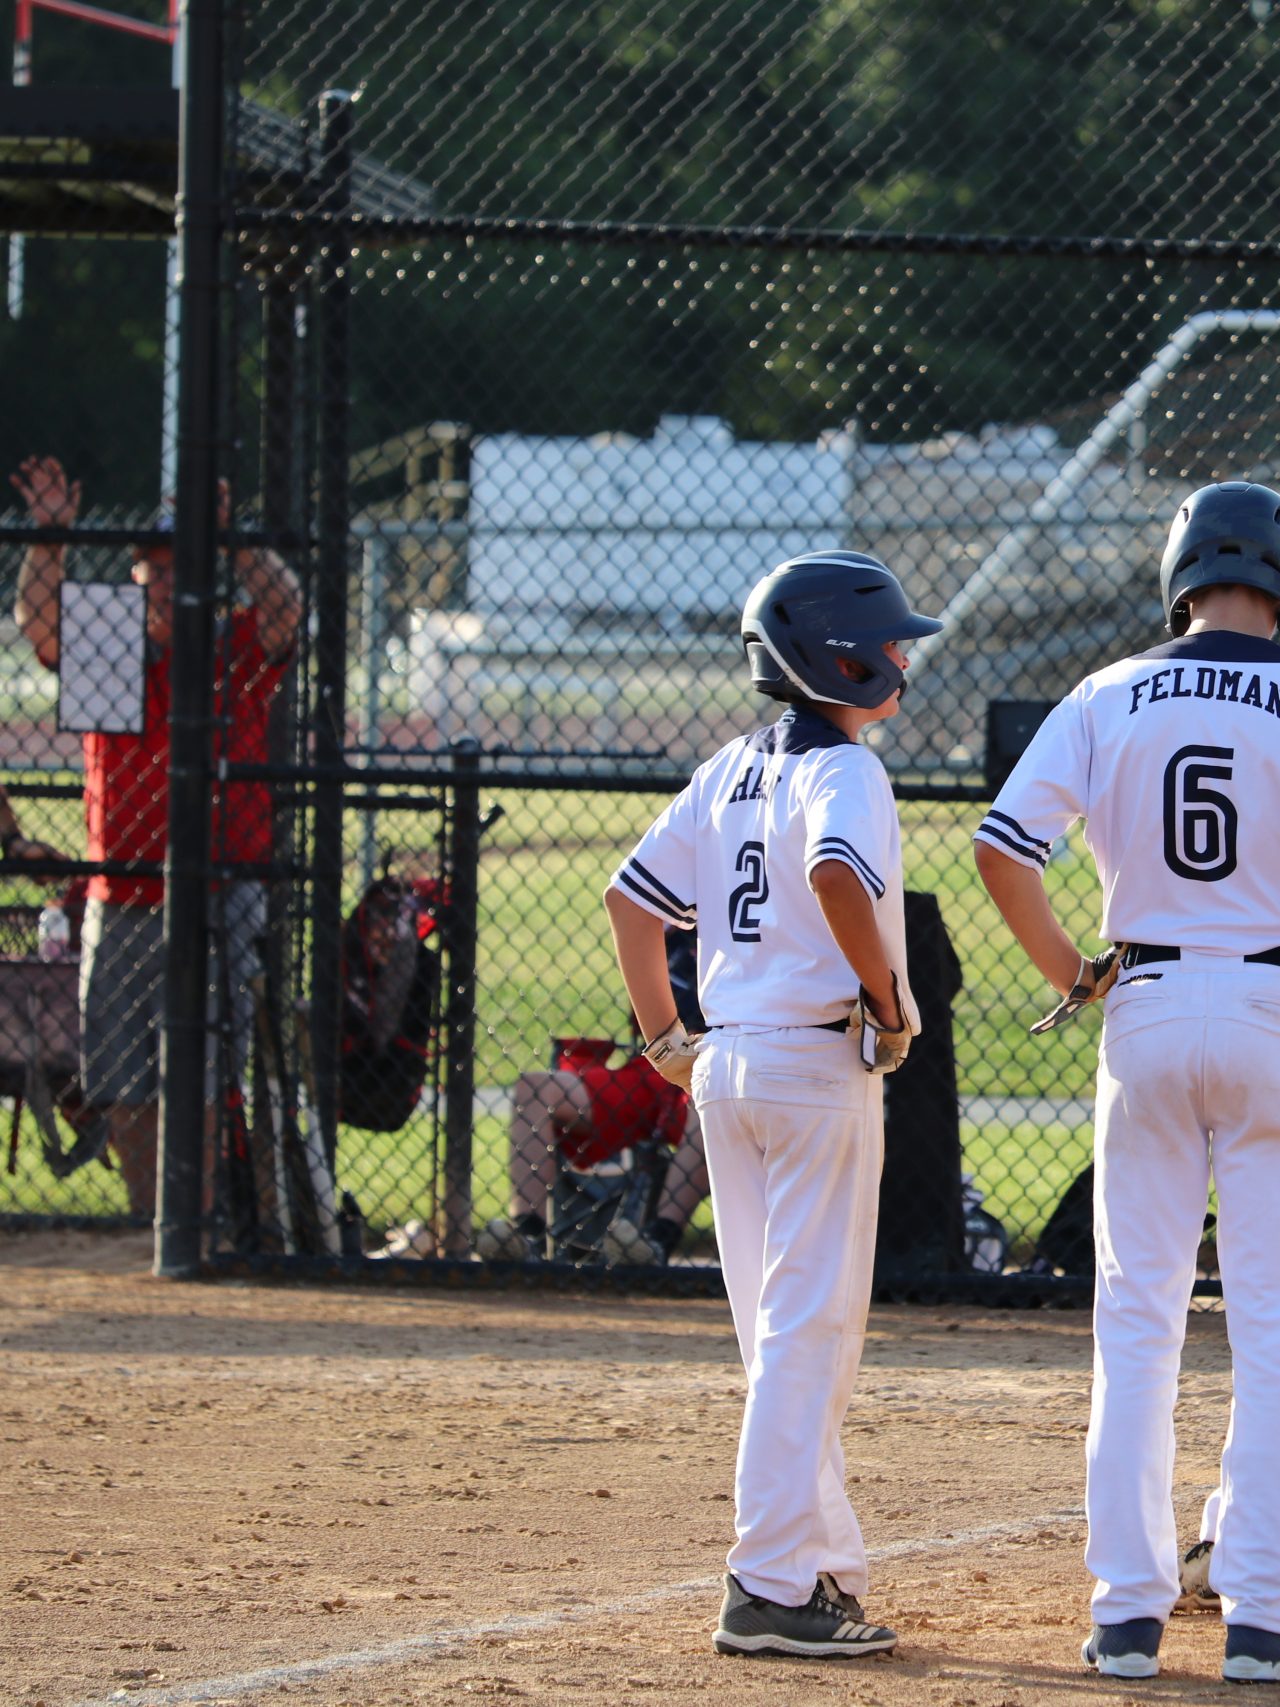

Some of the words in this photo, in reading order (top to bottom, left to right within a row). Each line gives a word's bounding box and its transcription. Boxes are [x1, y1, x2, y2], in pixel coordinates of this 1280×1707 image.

[825, 639, 857, 649] ELITE
[1163, 744, 1238, 882] 6
[729, 840, 770, 942] 2
